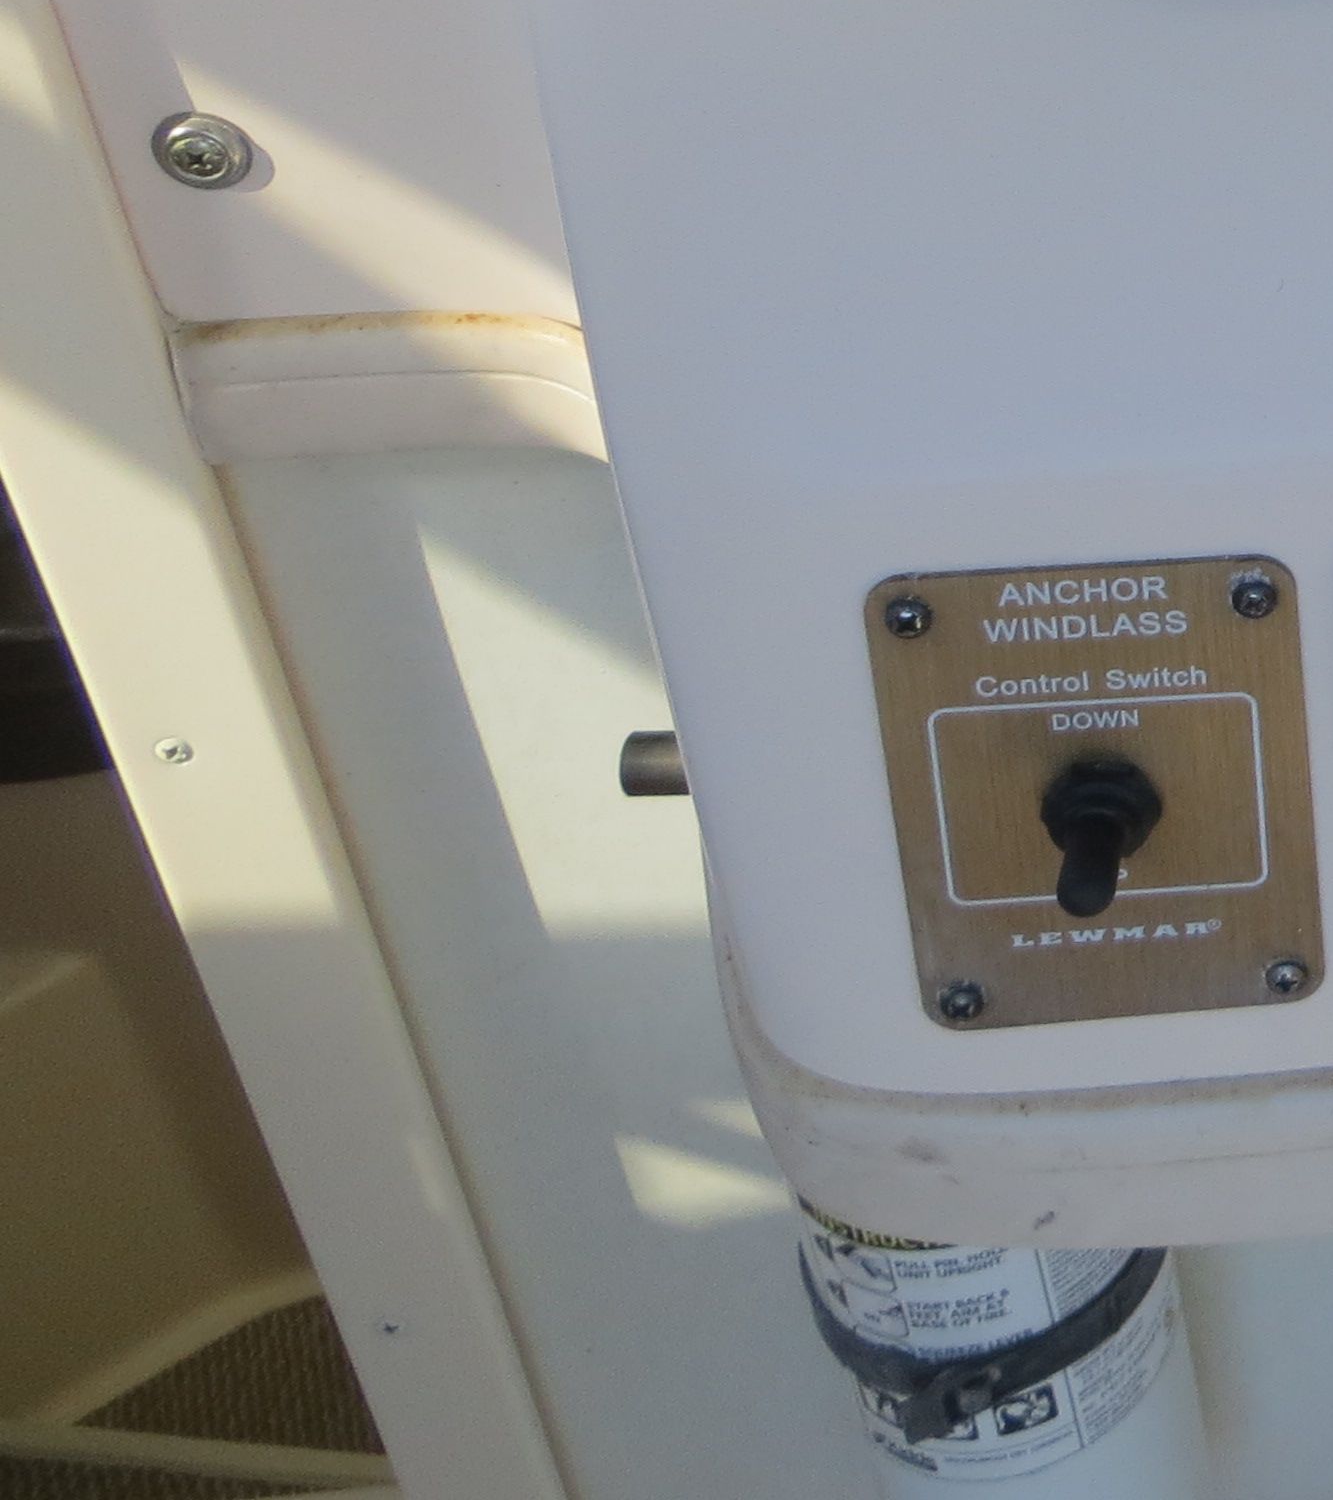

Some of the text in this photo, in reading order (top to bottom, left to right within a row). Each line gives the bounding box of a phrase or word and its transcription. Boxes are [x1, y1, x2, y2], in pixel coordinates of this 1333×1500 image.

[998, 575, 1169, 608] ANCHOR
[983, 610, 1189, 644] WINDLASS
[975, 664, 1208, 698] Control Switch
[1050, 708, 1142, 733] DOWN
